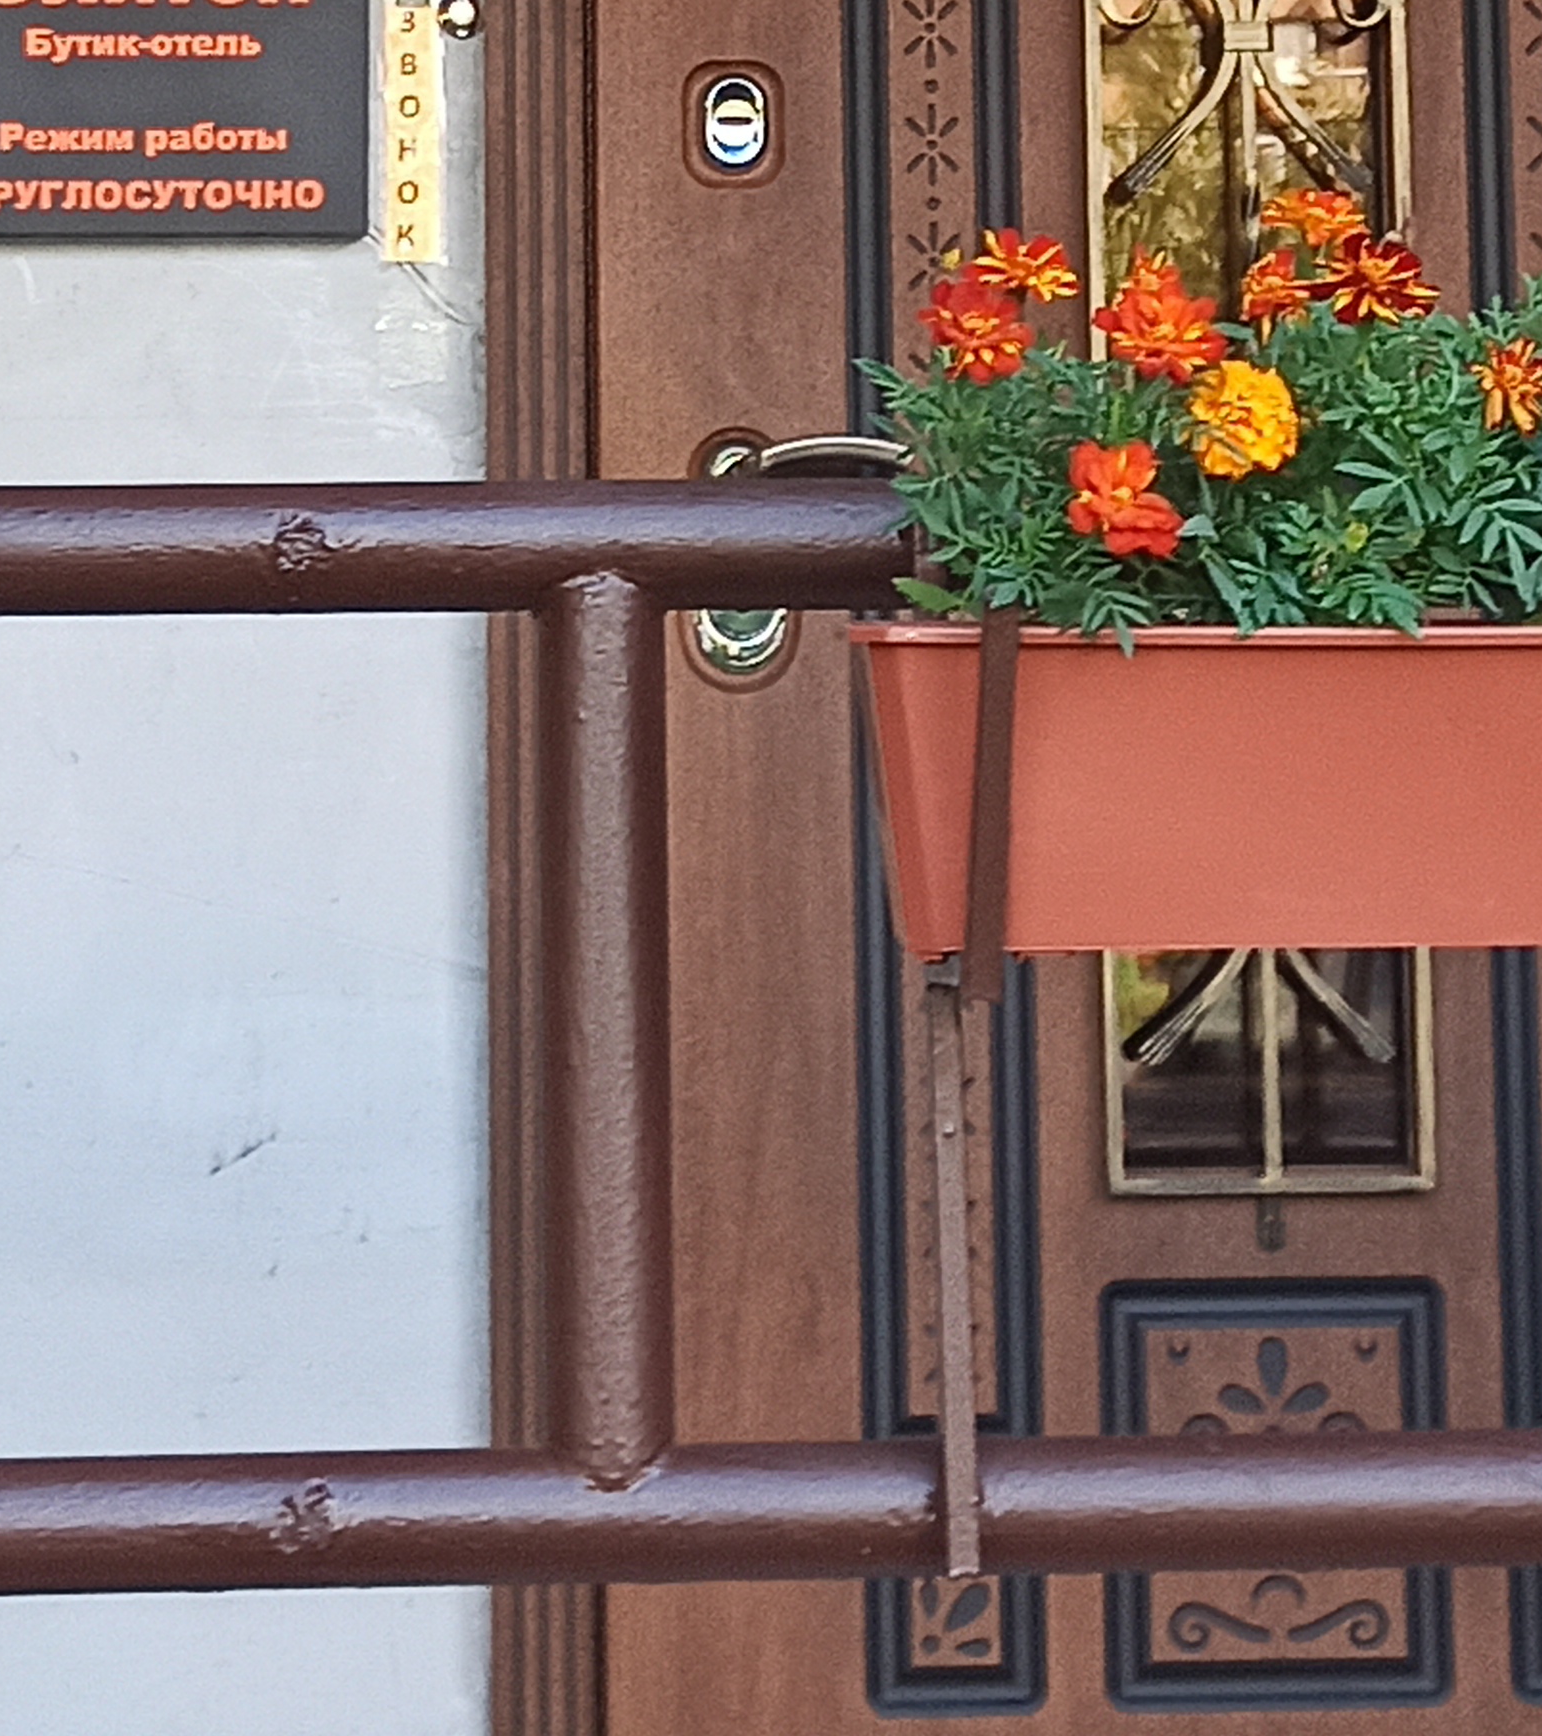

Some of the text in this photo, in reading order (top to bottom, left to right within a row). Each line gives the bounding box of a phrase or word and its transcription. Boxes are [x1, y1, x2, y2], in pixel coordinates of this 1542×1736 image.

[25, 27, 262, 63] Бутик-отель
[0, 122, 287, 156] Режим работы
[397, 10, 421, 248] ЗВОНОК
